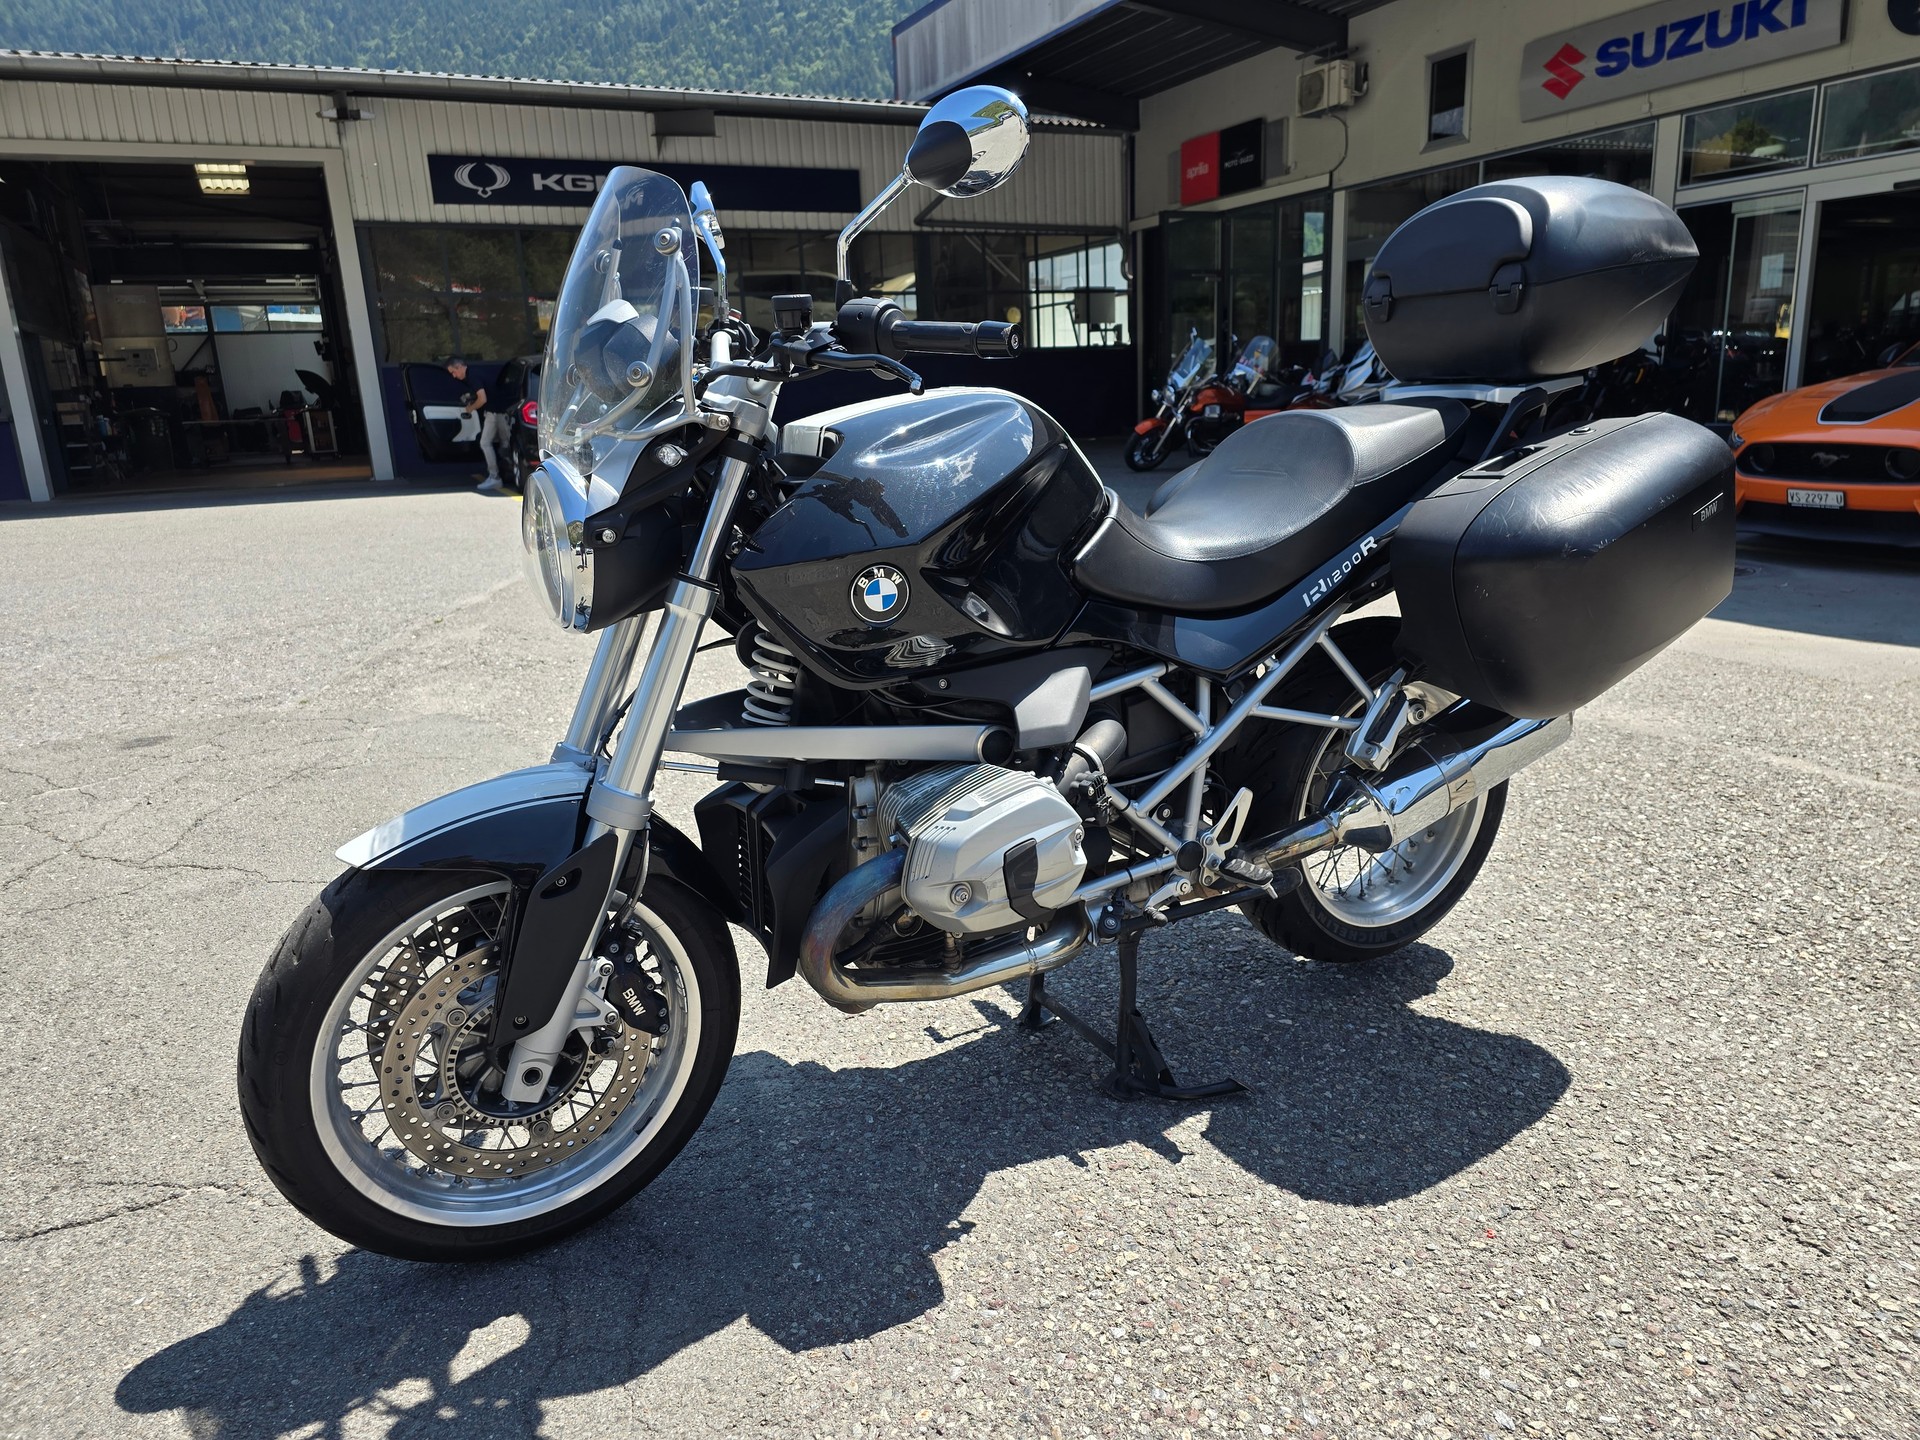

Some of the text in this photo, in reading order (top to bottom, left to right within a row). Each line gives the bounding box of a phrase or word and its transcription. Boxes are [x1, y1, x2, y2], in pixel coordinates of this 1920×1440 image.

[1595, 0, 1807, 78] SUZUKI
[1789, 492, 1843, 505] VS 2297 U
[1700, 500, 1718, 522] BMW
[857, 568, 903, 589] BMW
[622, 987, 647, 1016] BMW
